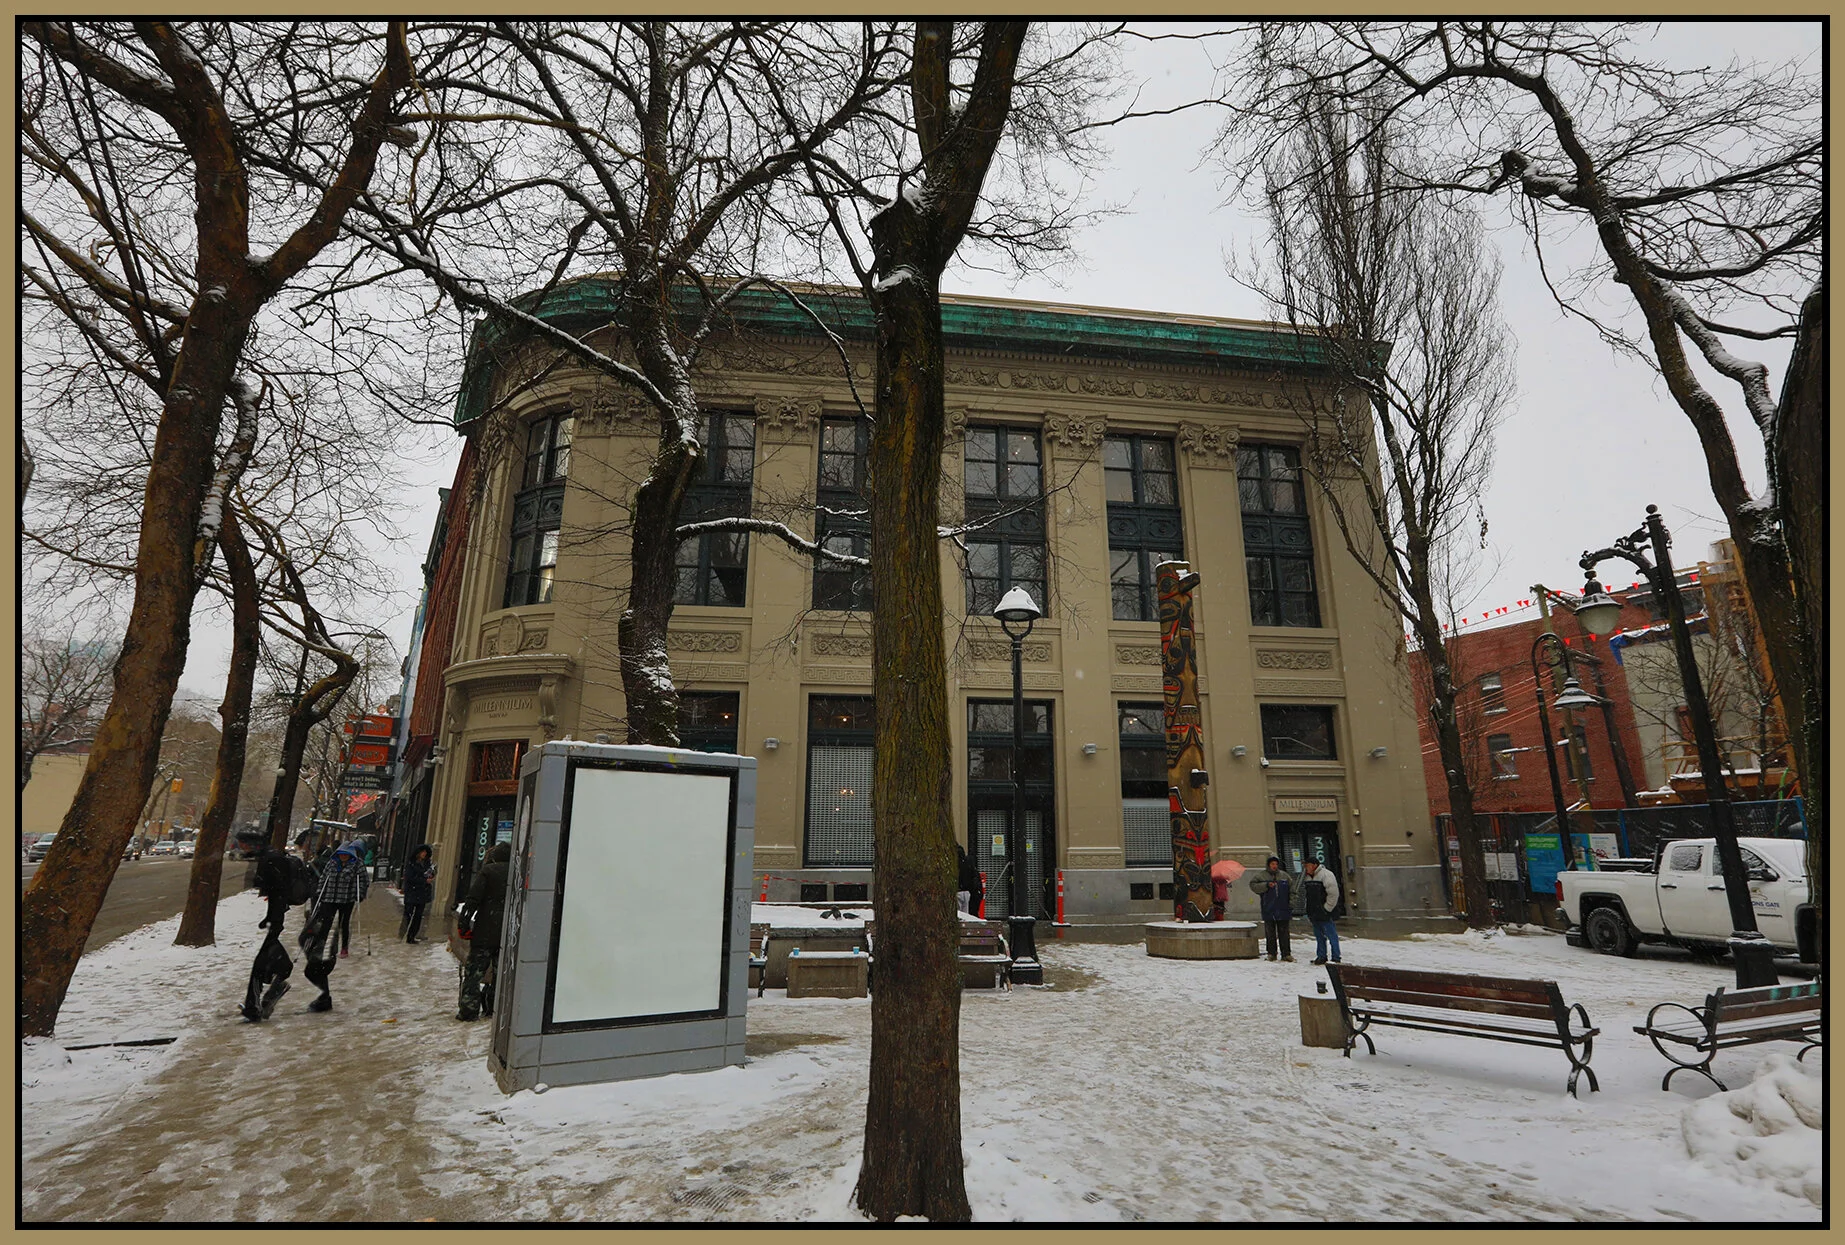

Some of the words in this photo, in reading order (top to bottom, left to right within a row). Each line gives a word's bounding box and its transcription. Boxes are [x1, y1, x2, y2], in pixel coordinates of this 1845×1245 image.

[474, 697, 533, 713] MILLENNIUM
[1279, 800, 1335, 809] MILLENNIUM
[478, 817, 489, 861] 389
